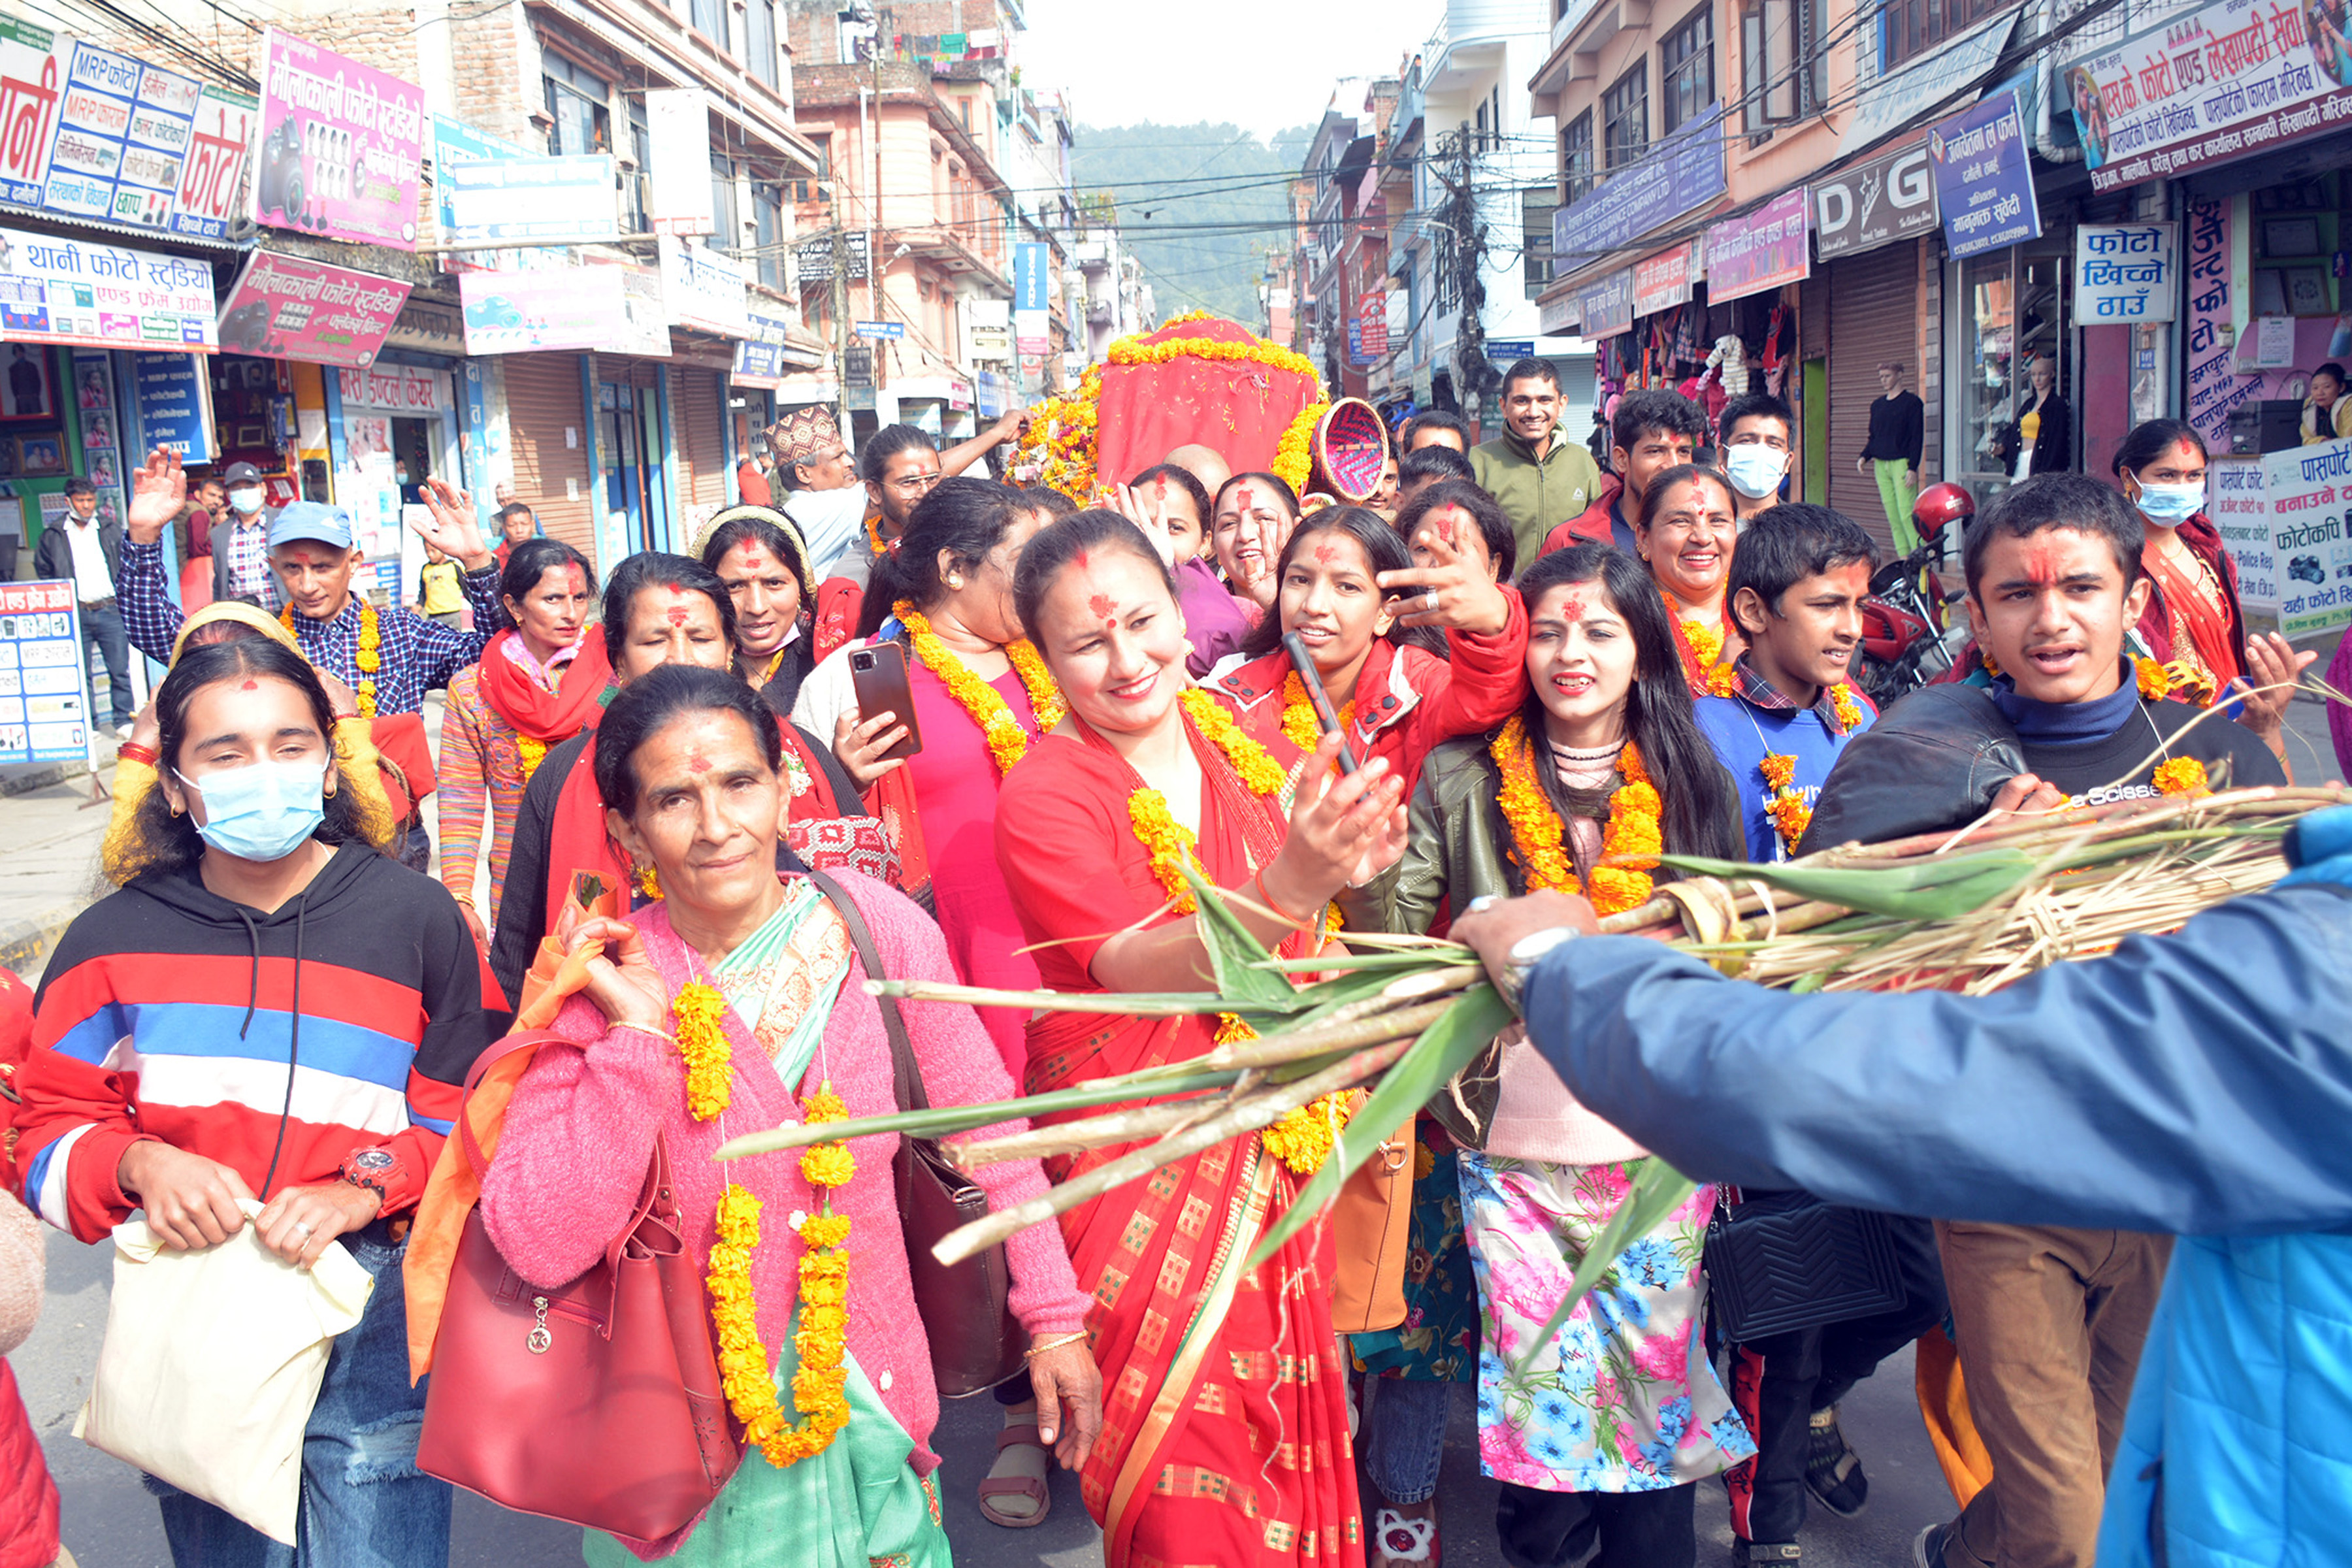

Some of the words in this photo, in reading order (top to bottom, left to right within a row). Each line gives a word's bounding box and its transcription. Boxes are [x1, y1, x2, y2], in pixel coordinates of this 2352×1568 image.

[2138, 50, 2175, 101] फोटो
[2172, 47, 2205, 91] एण्ड
[2204, 10, 2271, 81] लेखापढी
[2268, 1, 2305, 56] सेवा
[76, 52, 107, 82] MRP
[107, 62, 137, 91] फोटो
[67, 95, 97, 122] MRP
[344, 78, 378, 130] फोटो
[2144, 110, 2166, 144] फोटो
[182, 108, 246, 218] फोटो
[116, 191, 142, 215] छाप
[1818, 184, 1853, 237] D
[1887, 147, 1929, 209] G
[2087, 228, 2163, 255] फोटो
[27, 243, 82, 273] थानी
[89, 248, 140, 281] फोटो
[147, 259, 210, 292] स्टुडियो
[2082, 259, 2166, 286] खिच्ने
[96, 286, 131, 305] एण्ड
[139, 288, 169, 308] फ्रेम
[321, 278, 359, 306] फोटो
[2097, 288, 2149, 317] ठाउँ
[406, 366, 435, 409] केयर
[2301, 445, 2351, 482] पासपोर्ट
[2274, 485, 2336, 514] बनाउने
[2276, 516, 2341, 551] फोटोकपि
[2308, 587, 2336, 608] फोटो
[2089, 784, 2161, 805] Scisse
